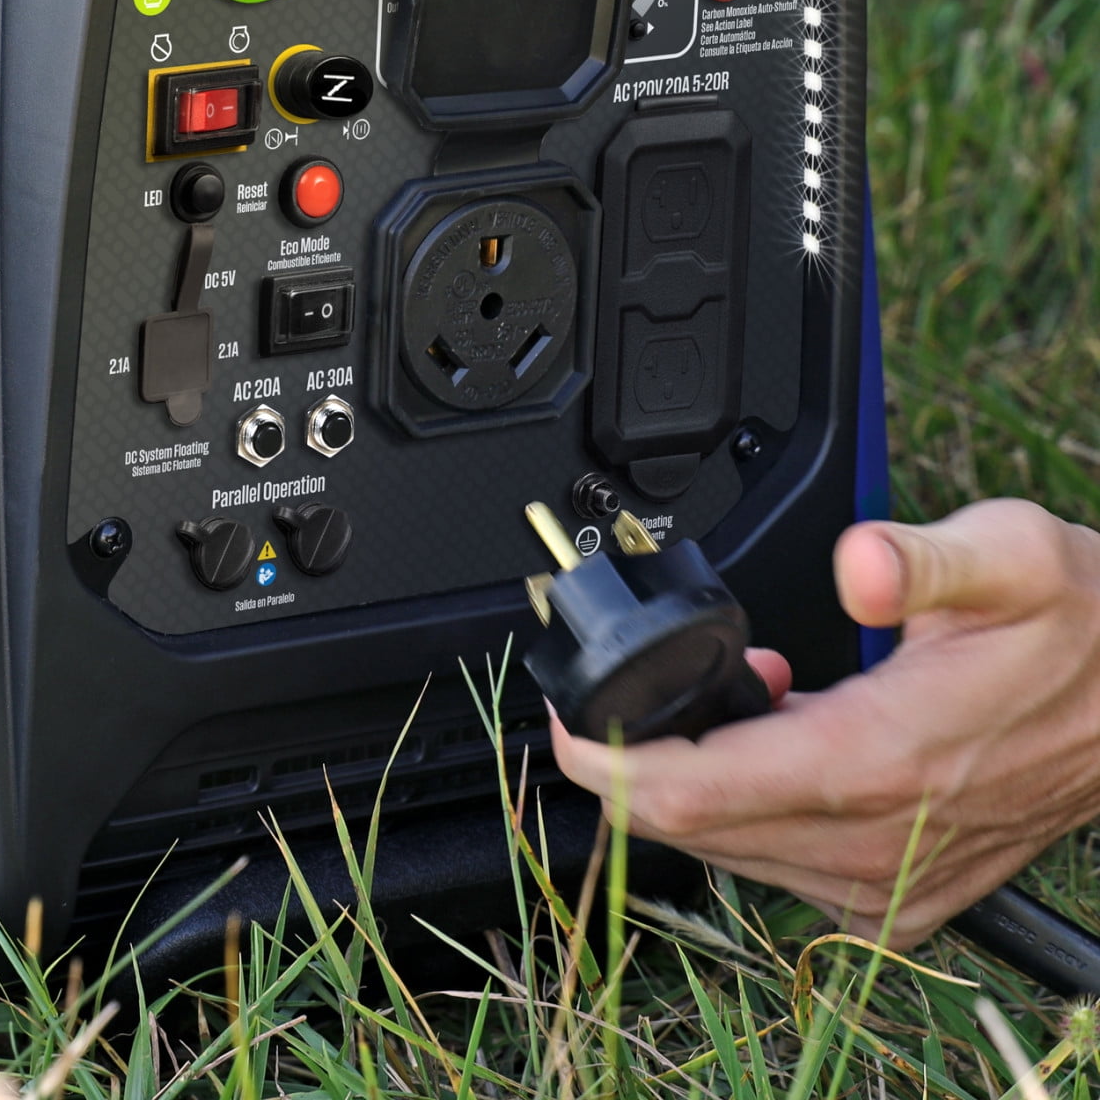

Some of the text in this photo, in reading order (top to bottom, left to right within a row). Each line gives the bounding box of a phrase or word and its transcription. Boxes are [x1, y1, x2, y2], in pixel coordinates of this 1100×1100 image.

[702, 0, 798, 20] Carbon Monoxide Auto-Shutoff
[701, 17, 753, 33] See Action Label
[699, 44, 728, 58] Consulte
[735, 41, 762, 55] Etiqueta
[762, 39, 771, 51] de
[700, 34, 719, 46] Corte
[612, 71, 730, 103] AC 120V 20A 5-20R
[144, 189, 163, 207] LED
[237, 181, 268, 201] Reset
[236, 200, 268, 214] Reiniciar
[280, 235, 330, 256] Eco Mode
[267, 252, 342, 271] Combustible Eficiente
[204, 269, 237, 290] DC 5V
[218, 341, 239, 359] 2.1A
[109, 357, 130, 375] 2.1A
[233, 376, 281, 402] AC 20A
[306, 366, 354, 392] AC 30A
[124, 441, 210, 466] DC System Floating
[131, 457, 202, 477] Sistema DC Flotante
[212, 474, 326, 509] Parallel Operation
[235, 592, 295, 612] Salida en Paralelo
